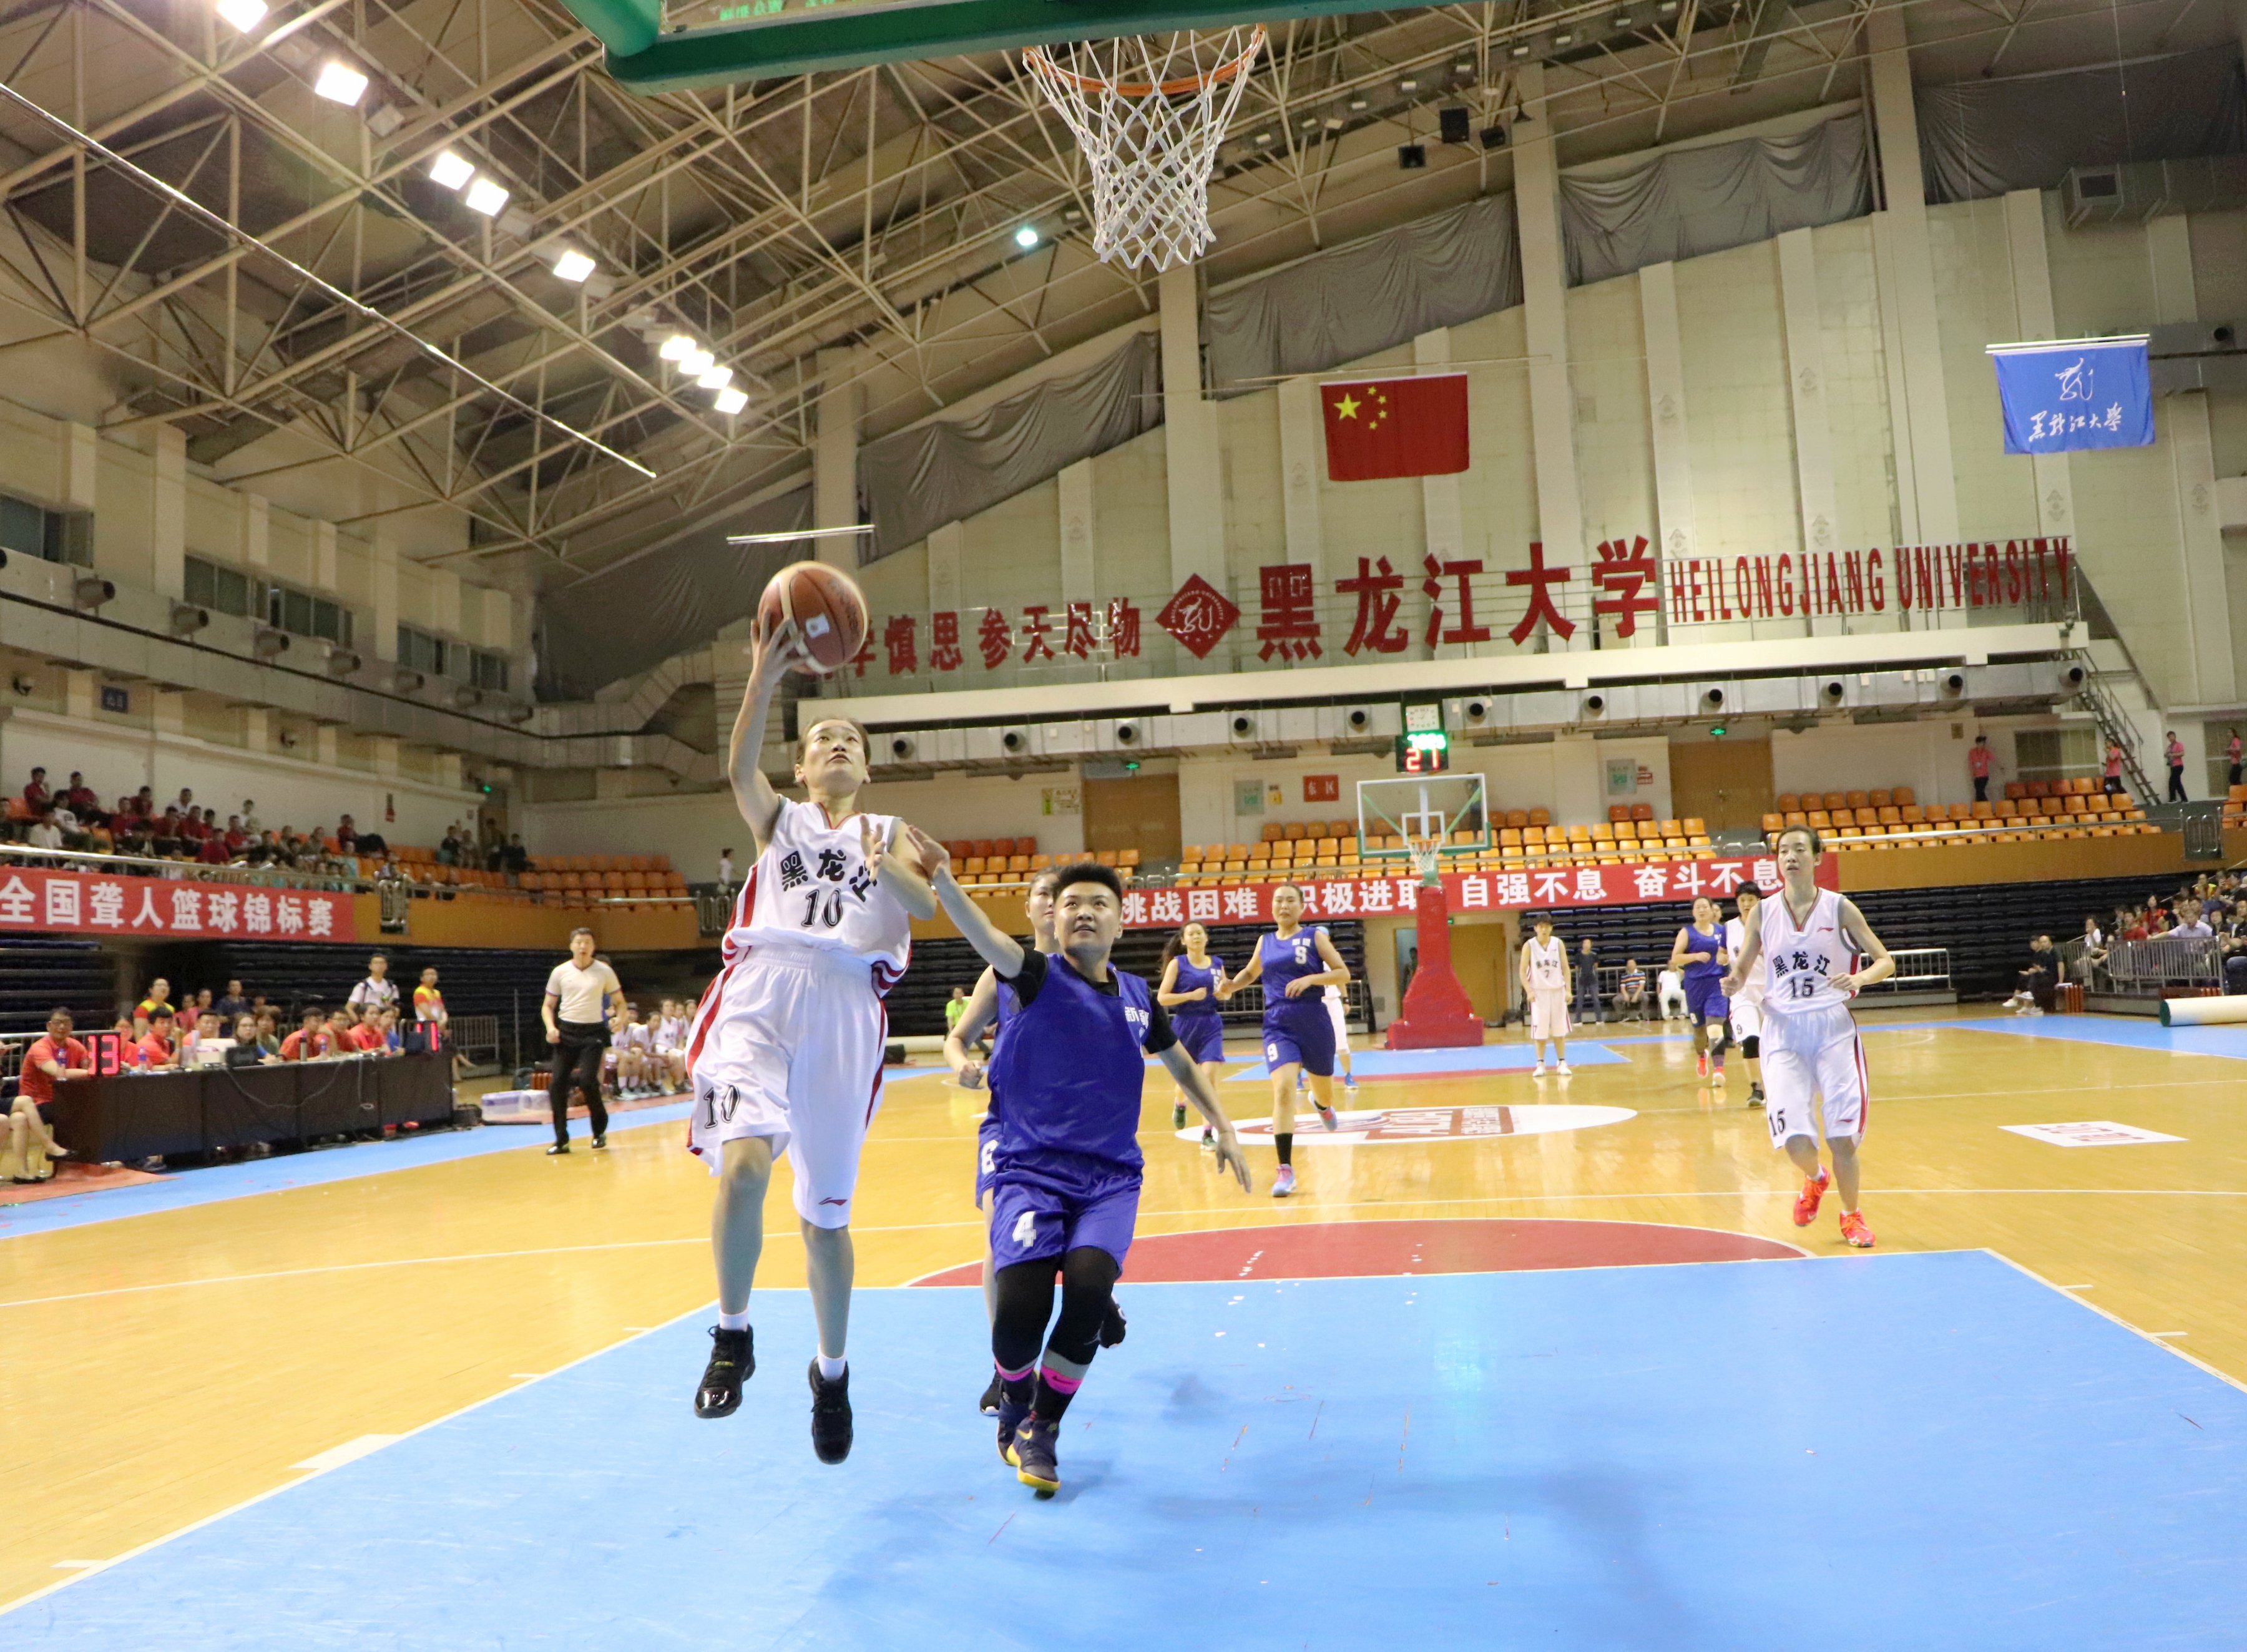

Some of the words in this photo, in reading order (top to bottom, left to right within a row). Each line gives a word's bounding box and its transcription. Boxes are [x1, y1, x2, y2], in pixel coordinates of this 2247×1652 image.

[1256, 535, 1660, 662] 黑龙江大学
[1670, 547, 1885, 623] HEILONGJIANG
[1895, 538, 2068, 610] UNIVERSITY
[0, 875, 333, 936] 全国聋人篮球锦标赛
[801, 887, 844, 929] 10
[1121, 887, 1258, 924] 挑战困难
[1462, 868, 1608, 907] 自强不息
[1634, 858, 1784, 898] 奋斗不息
[1295, 946, 1307, 964] 9
[1773, 951, 1831, 979] 黑龙江
[1789, 976, 1814, 998] 15
[1266, 1043, 1278, 1062] 9
[703, 1084, 741, 1129] 10
[1769, 1107, 1786, 1137] 15
[1012, 1211, 1037, 1248] 4
